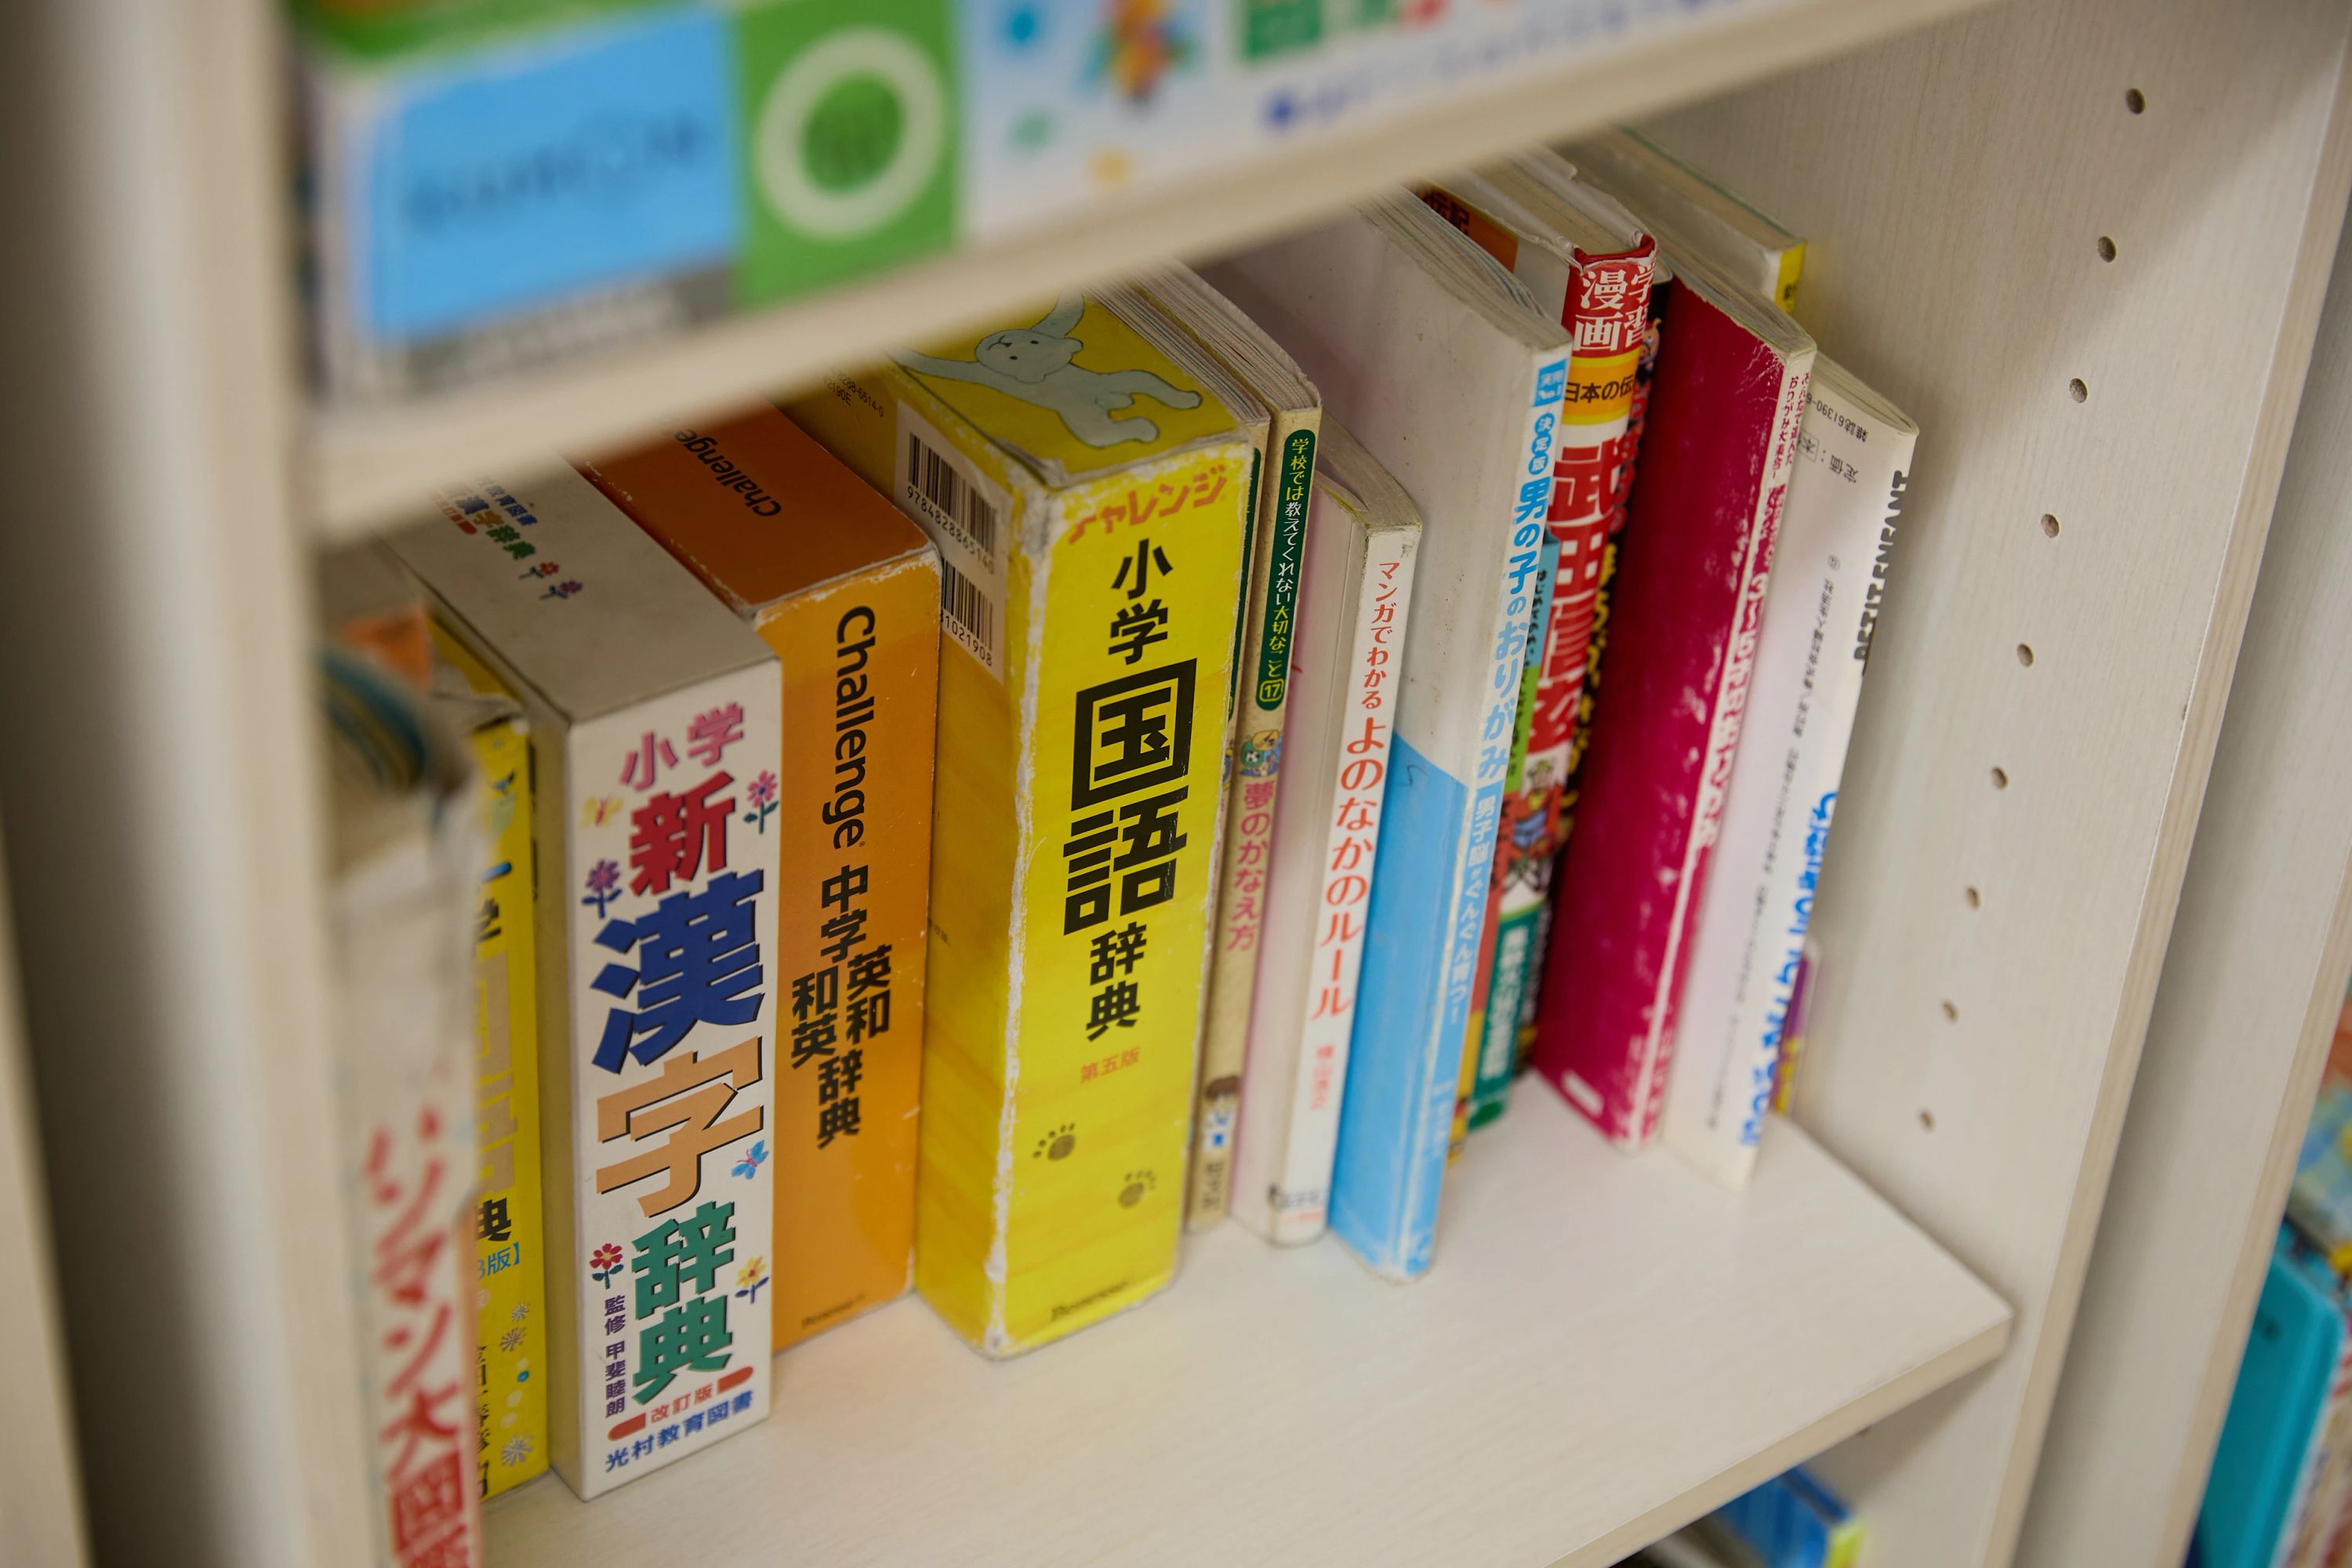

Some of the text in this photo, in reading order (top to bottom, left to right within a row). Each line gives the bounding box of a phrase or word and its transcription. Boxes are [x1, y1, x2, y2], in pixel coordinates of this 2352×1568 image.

[674, 429, 782, 517] Challenge
[1268, 438, 1309, 677] 学校では教えてくれない大切なこと
[1477, 476, 1551, 779] 男の子のおりがみ
[1362, 561, 1401, 710] マンガでわかる
[619, 702, 746, 791] 小学
[822, 605, 876, 850] Challenge
[1225, 780, 1274, 952] 夢のかなえ方
[1311, 717, 1387, 1021] よのなかのルール
[604, 1296, 626, 1336] 監修
[605, 1390, 754, 1472] 光村教育図書
[651, 1384, 713, 1424] 改訂版
